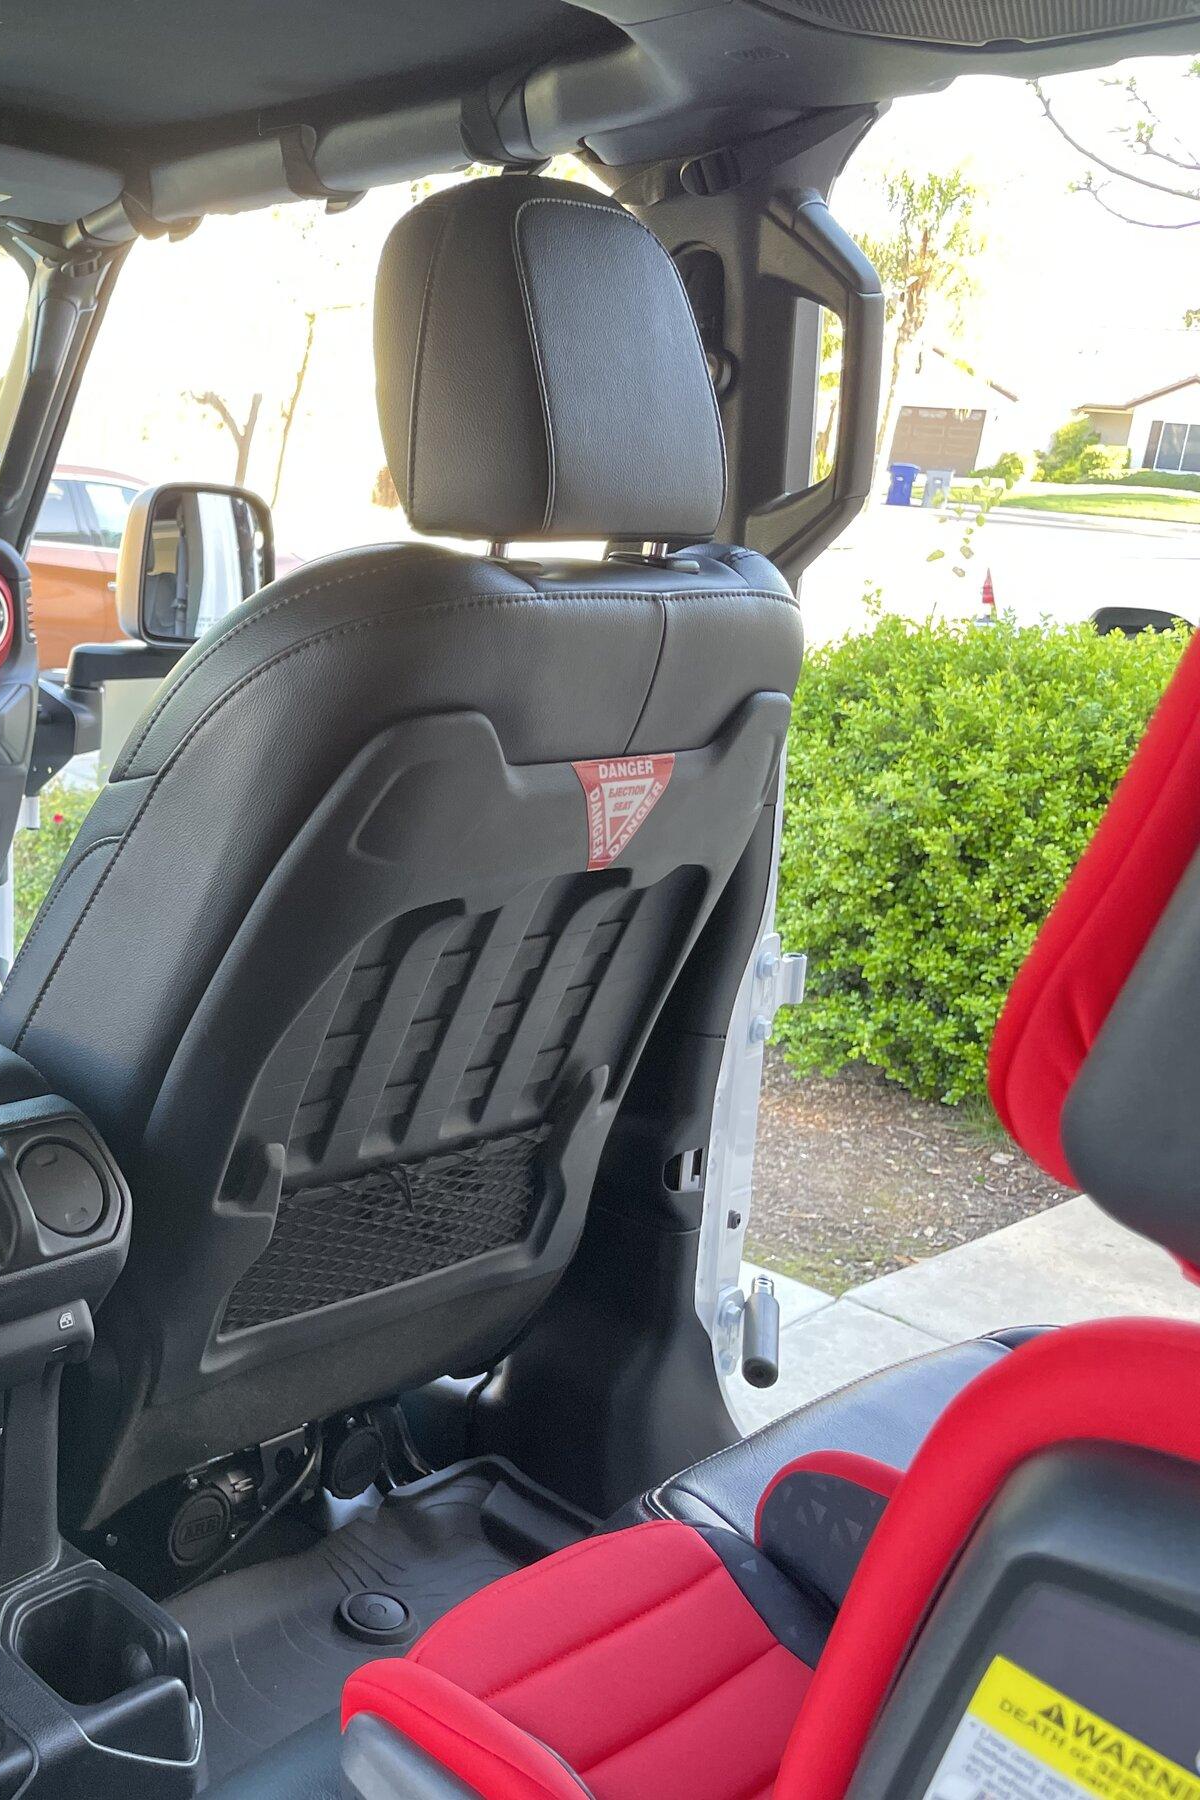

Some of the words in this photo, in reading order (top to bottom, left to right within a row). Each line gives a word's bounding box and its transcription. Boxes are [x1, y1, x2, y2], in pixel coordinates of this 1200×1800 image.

[599, 760, 654, 779] DANGER
[608, 785, 646, 798] EJECTION
[613, 801, 633, 812] SEAT
[589, 786, 604, 859] DANGER
[608, 782, 663, 857] DANGER
[999, 1698, 1066, 1749] DEATH
